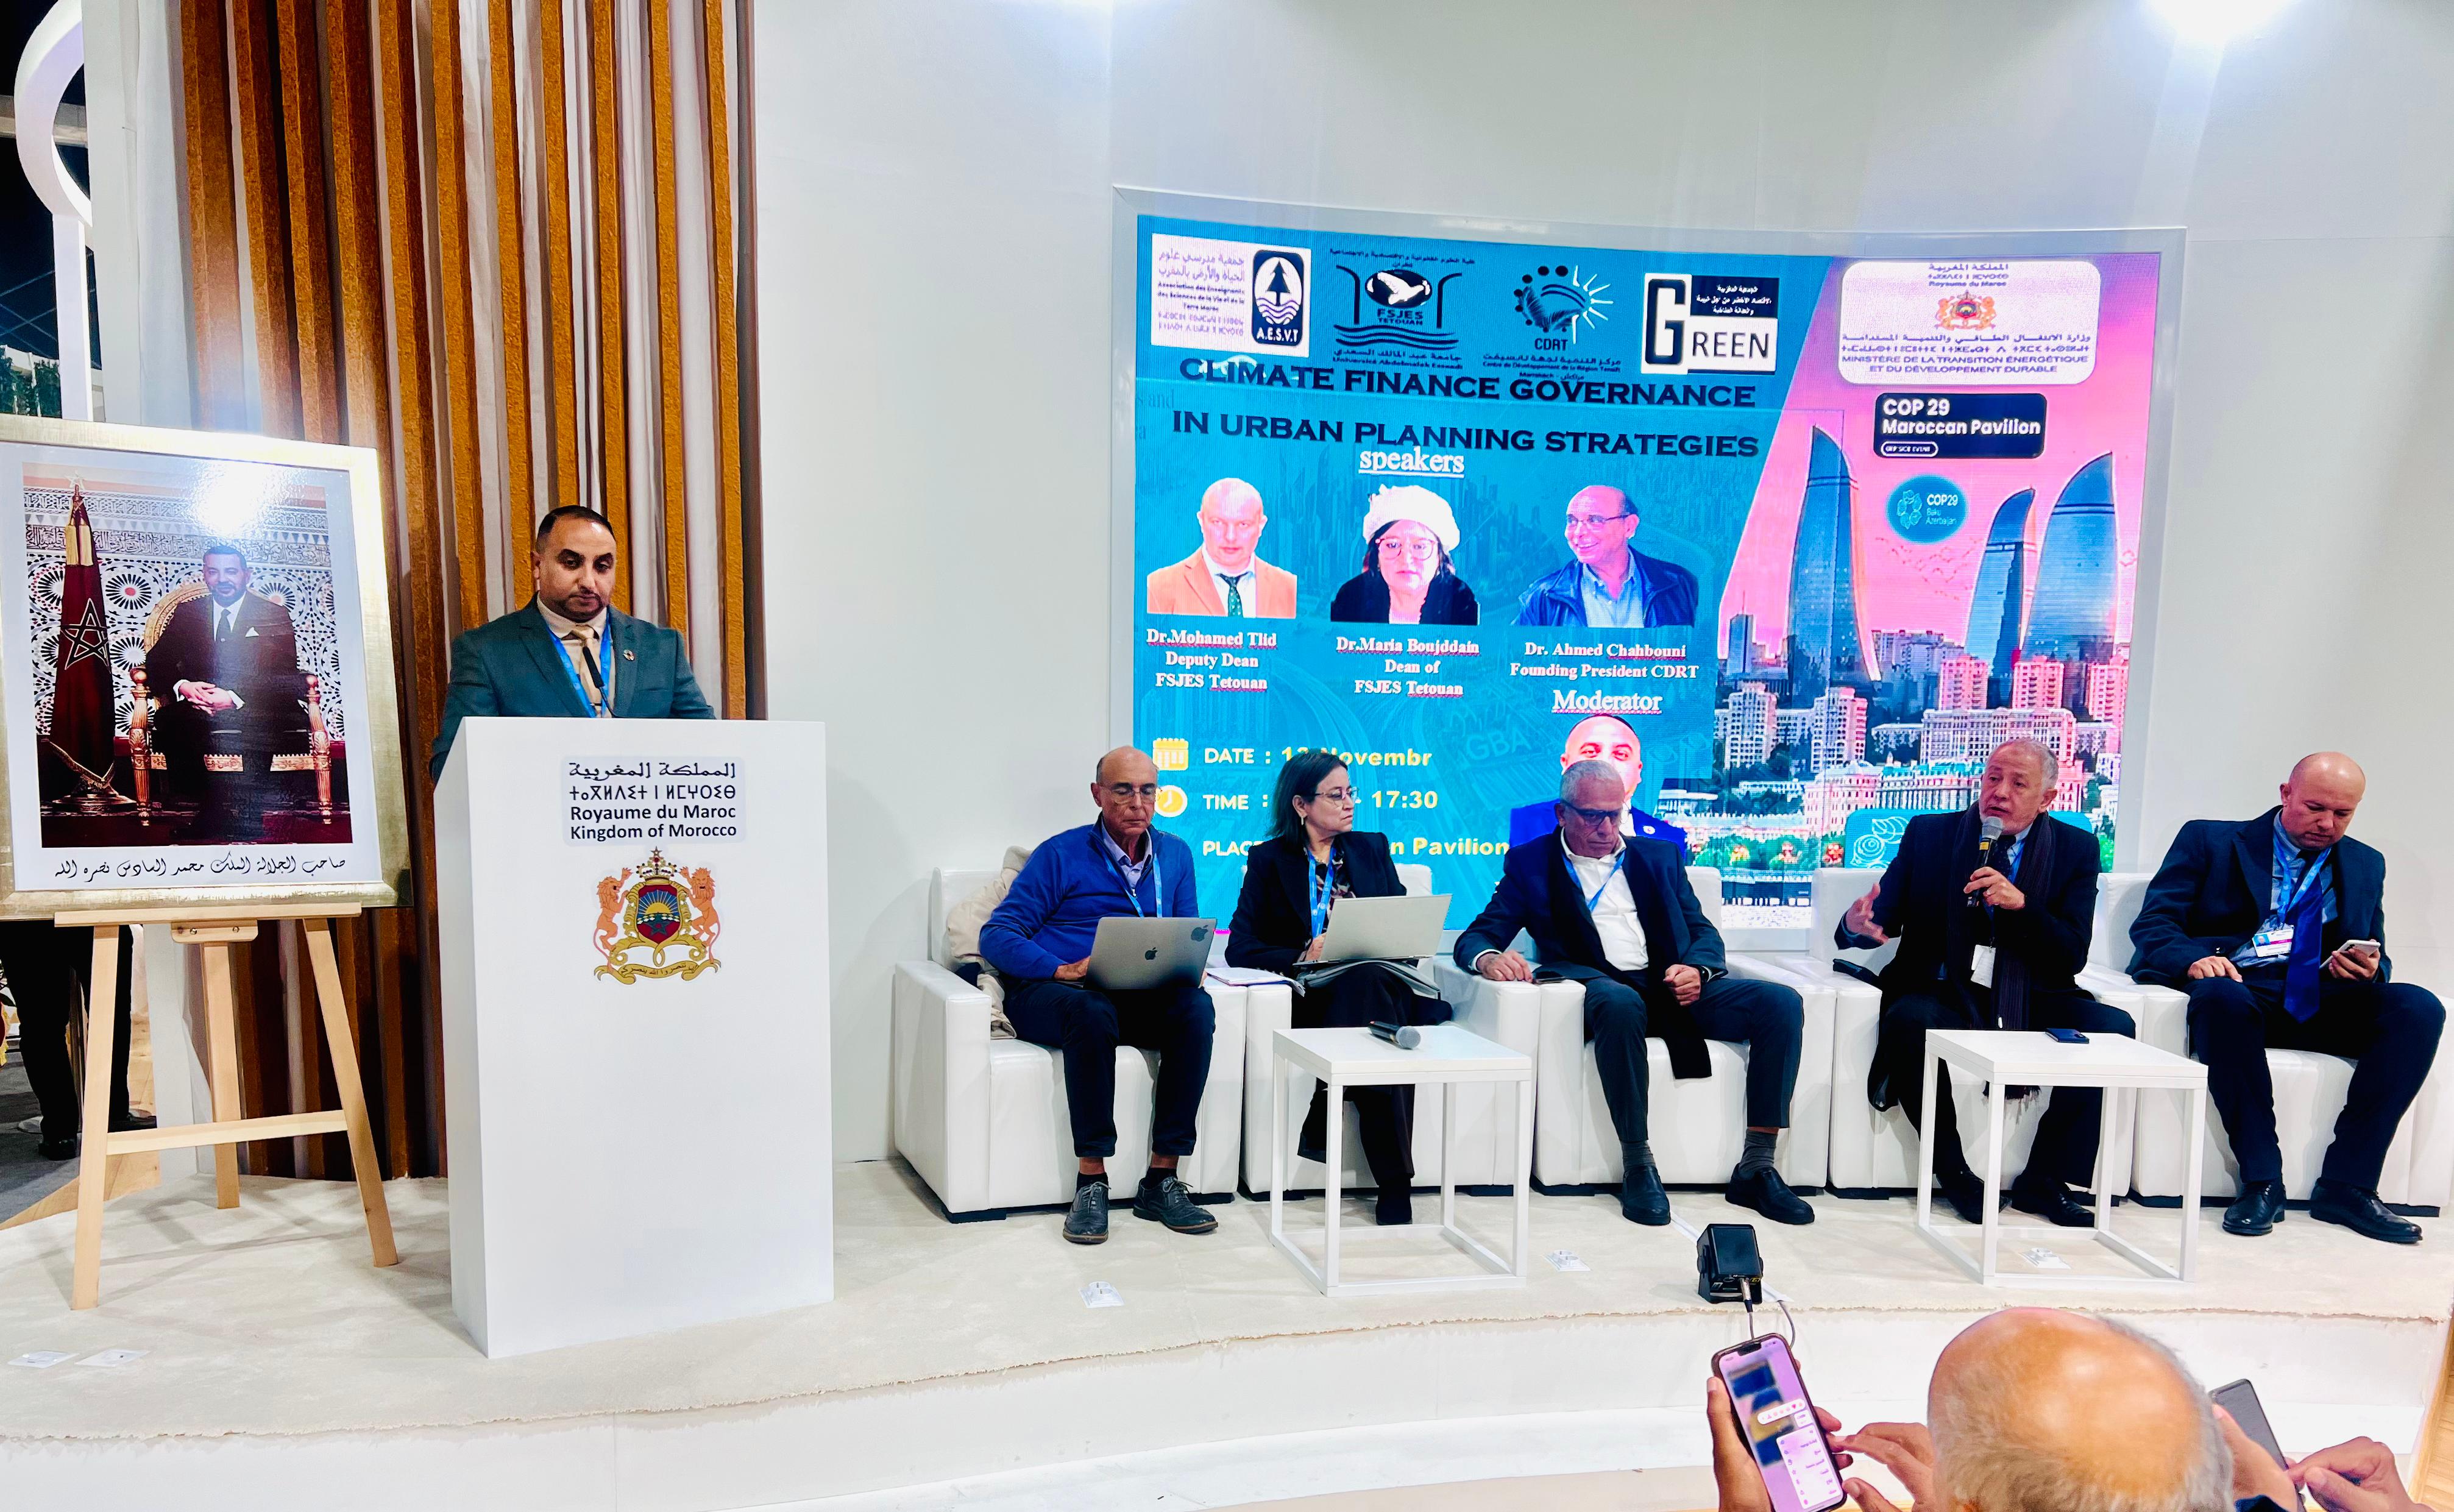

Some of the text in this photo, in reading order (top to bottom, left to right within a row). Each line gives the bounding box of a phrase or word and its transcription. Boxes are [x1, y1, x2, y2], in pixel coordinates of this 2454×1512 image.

[1928, 263, 1968, 273] المغربية
[1377, 308, 1424, 319] FSJES
[1534, 338, 1568, 351] CDRT
[2067, 334, 2091, 343] وزارة
[1180, 358, 1756, 408] CLIMATE FINANCE GOVERNANCE
[1883, 399, 1950, 416] COP 29
[1173, 410, 1208, 434] IN
[1221, 414, 1342, 444] URBAN
[1354, 421, 1535, 451] PLANNING
[1545, 430, 1759, 458] STRATEGIES
[1971, 419, 2041, 435] Pavilion
[1360, 445, 1465, 474] speakers
[1927, 494, 1958, 506] COP29
[1147, 629, 1243, 646] Dr.Mohamed
[1336, 637, 1403, 652] Dr.Maria
[1525, 642, 1686, 658] Dr. Ahmed Chahbouni
[1166, 651, 1259, 670] Deputy Dean
[1385, 659, 1441, 674] Dean of
[1510, 662, 1700, 680] Founding President CDRT
[1155, 673, 1268, 690] FSJES Tetouan
[1354, 680, 1464, 695] FSJES Tetouan
[1552, 689, 1663, 711] Moderator
[1204, 748, 1255, 764] DATE
[569, 762, 736, 782] المملكة المغربية
[1202, 794, 1249, 810] TIME
[1372, 790, 1438, 809] 17:30
[570, 804, 736, 823] Royaume du Maroc
[570, 823, 737, 842] Kingdom of Morocco
[1202, 840, 1264, 856] PLAC
[1413, 837, 1509, 856] Pavilion
[55, 851, 346, 883] صاحب الجلالة الملك محمد السادس نصره الله
